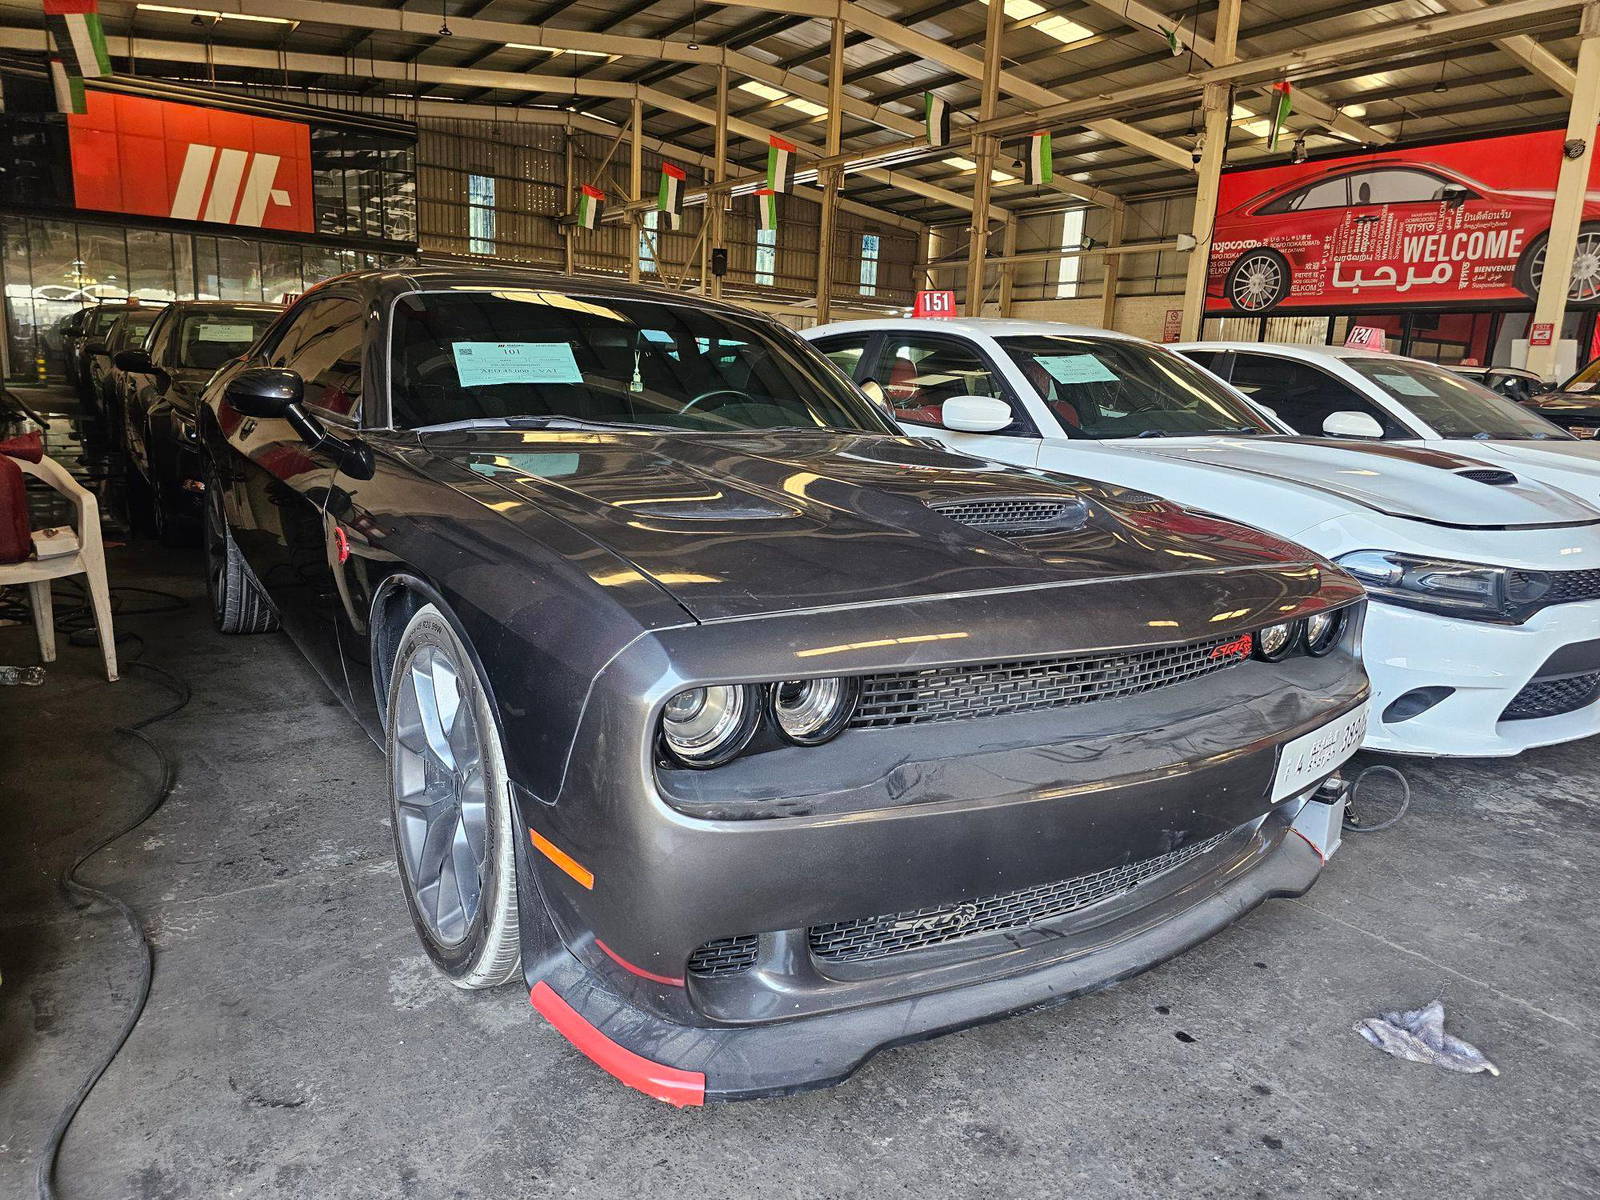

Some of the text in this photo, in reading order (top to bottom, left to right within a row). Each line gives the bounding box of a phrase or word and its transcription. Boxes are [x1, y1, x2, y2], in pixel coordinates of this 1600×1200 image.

[1381, 213, 1394, 260] WILLKOMMEN
[1403, 229, 1525, 263] WELCOME
[1474, 264, 1516, 273] BIENVENUE
[1333, 263, 1453, 294] مرحبا
[924, 293, 949, 311] 151
[1352, 328, 1371, 344] 124
[1295, 754, 1304, 775] 4
[888, 914, 960, 930] SRT
